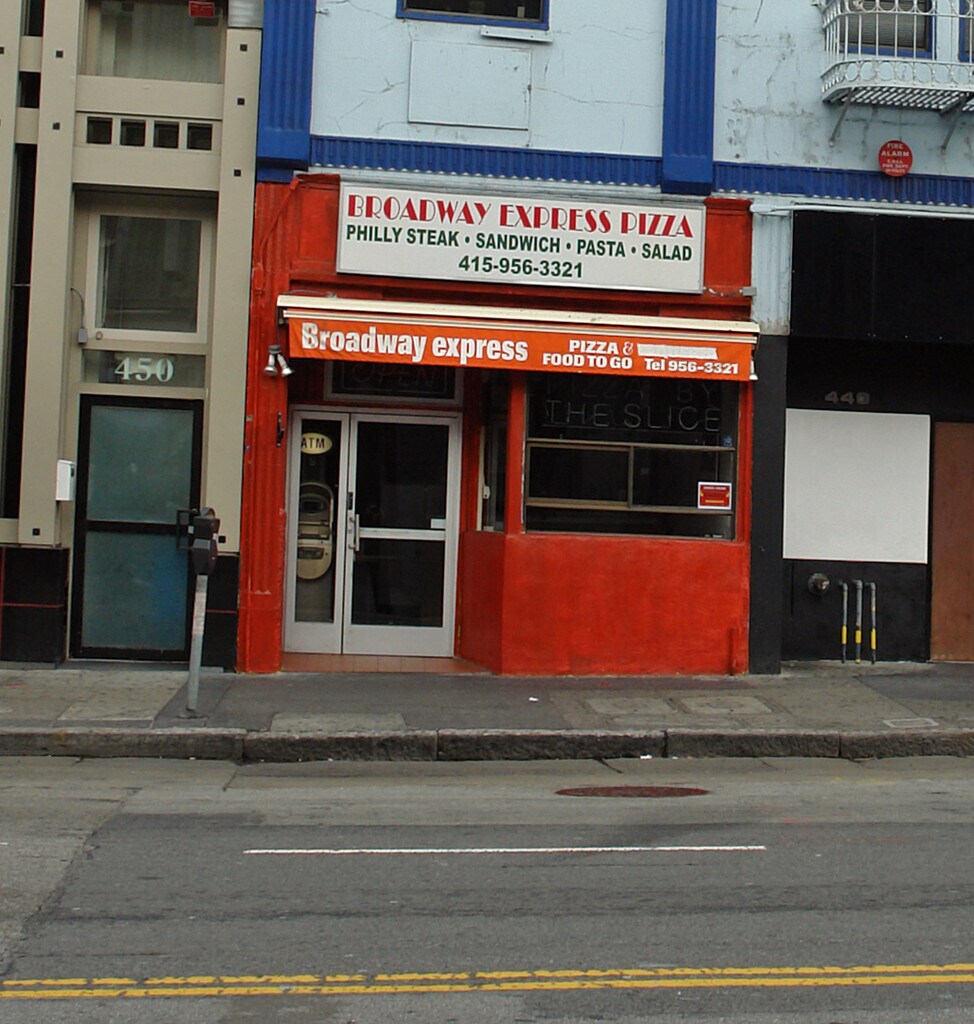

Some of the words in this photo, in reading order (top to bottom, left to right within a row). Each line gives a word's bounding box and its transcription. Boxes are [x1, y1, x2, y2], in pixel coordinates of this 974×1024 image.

[347, 194, 491, 225] BROADWAY
[500, 204, 612, 233] EXPRESS
[621, 212, 693, 238] PIZZA
[346, 224, 402, 243] PHILLY
[406, 228, 460, 247] STEAK
[475, 232, 560, 253] SANDWICH
[577, 239, 626, 257] PASTA
[641, 243, 693, 261] SALAD
[458, 255, 583, 278] 415-956-3321
[301, 322, 427, 363] Broadway
[431, 335, 529, 365] express
[569, 340, 619, 355] PIZZA
[622, 341, 634, 355] &
[114, 357, 174, 382] 450
[542, 353, 587, 368] FOOD
[588, 355, 608, 368] TO
[610, 356, 633, 369] GO
[644, 357, 666, 371] Tel
[668, 360, 739, 374] 956-3321
[546, 399, 610, 427] THE
[623, 403, 721, 432] SLICE
[301, 437, 325, 449] ATM
